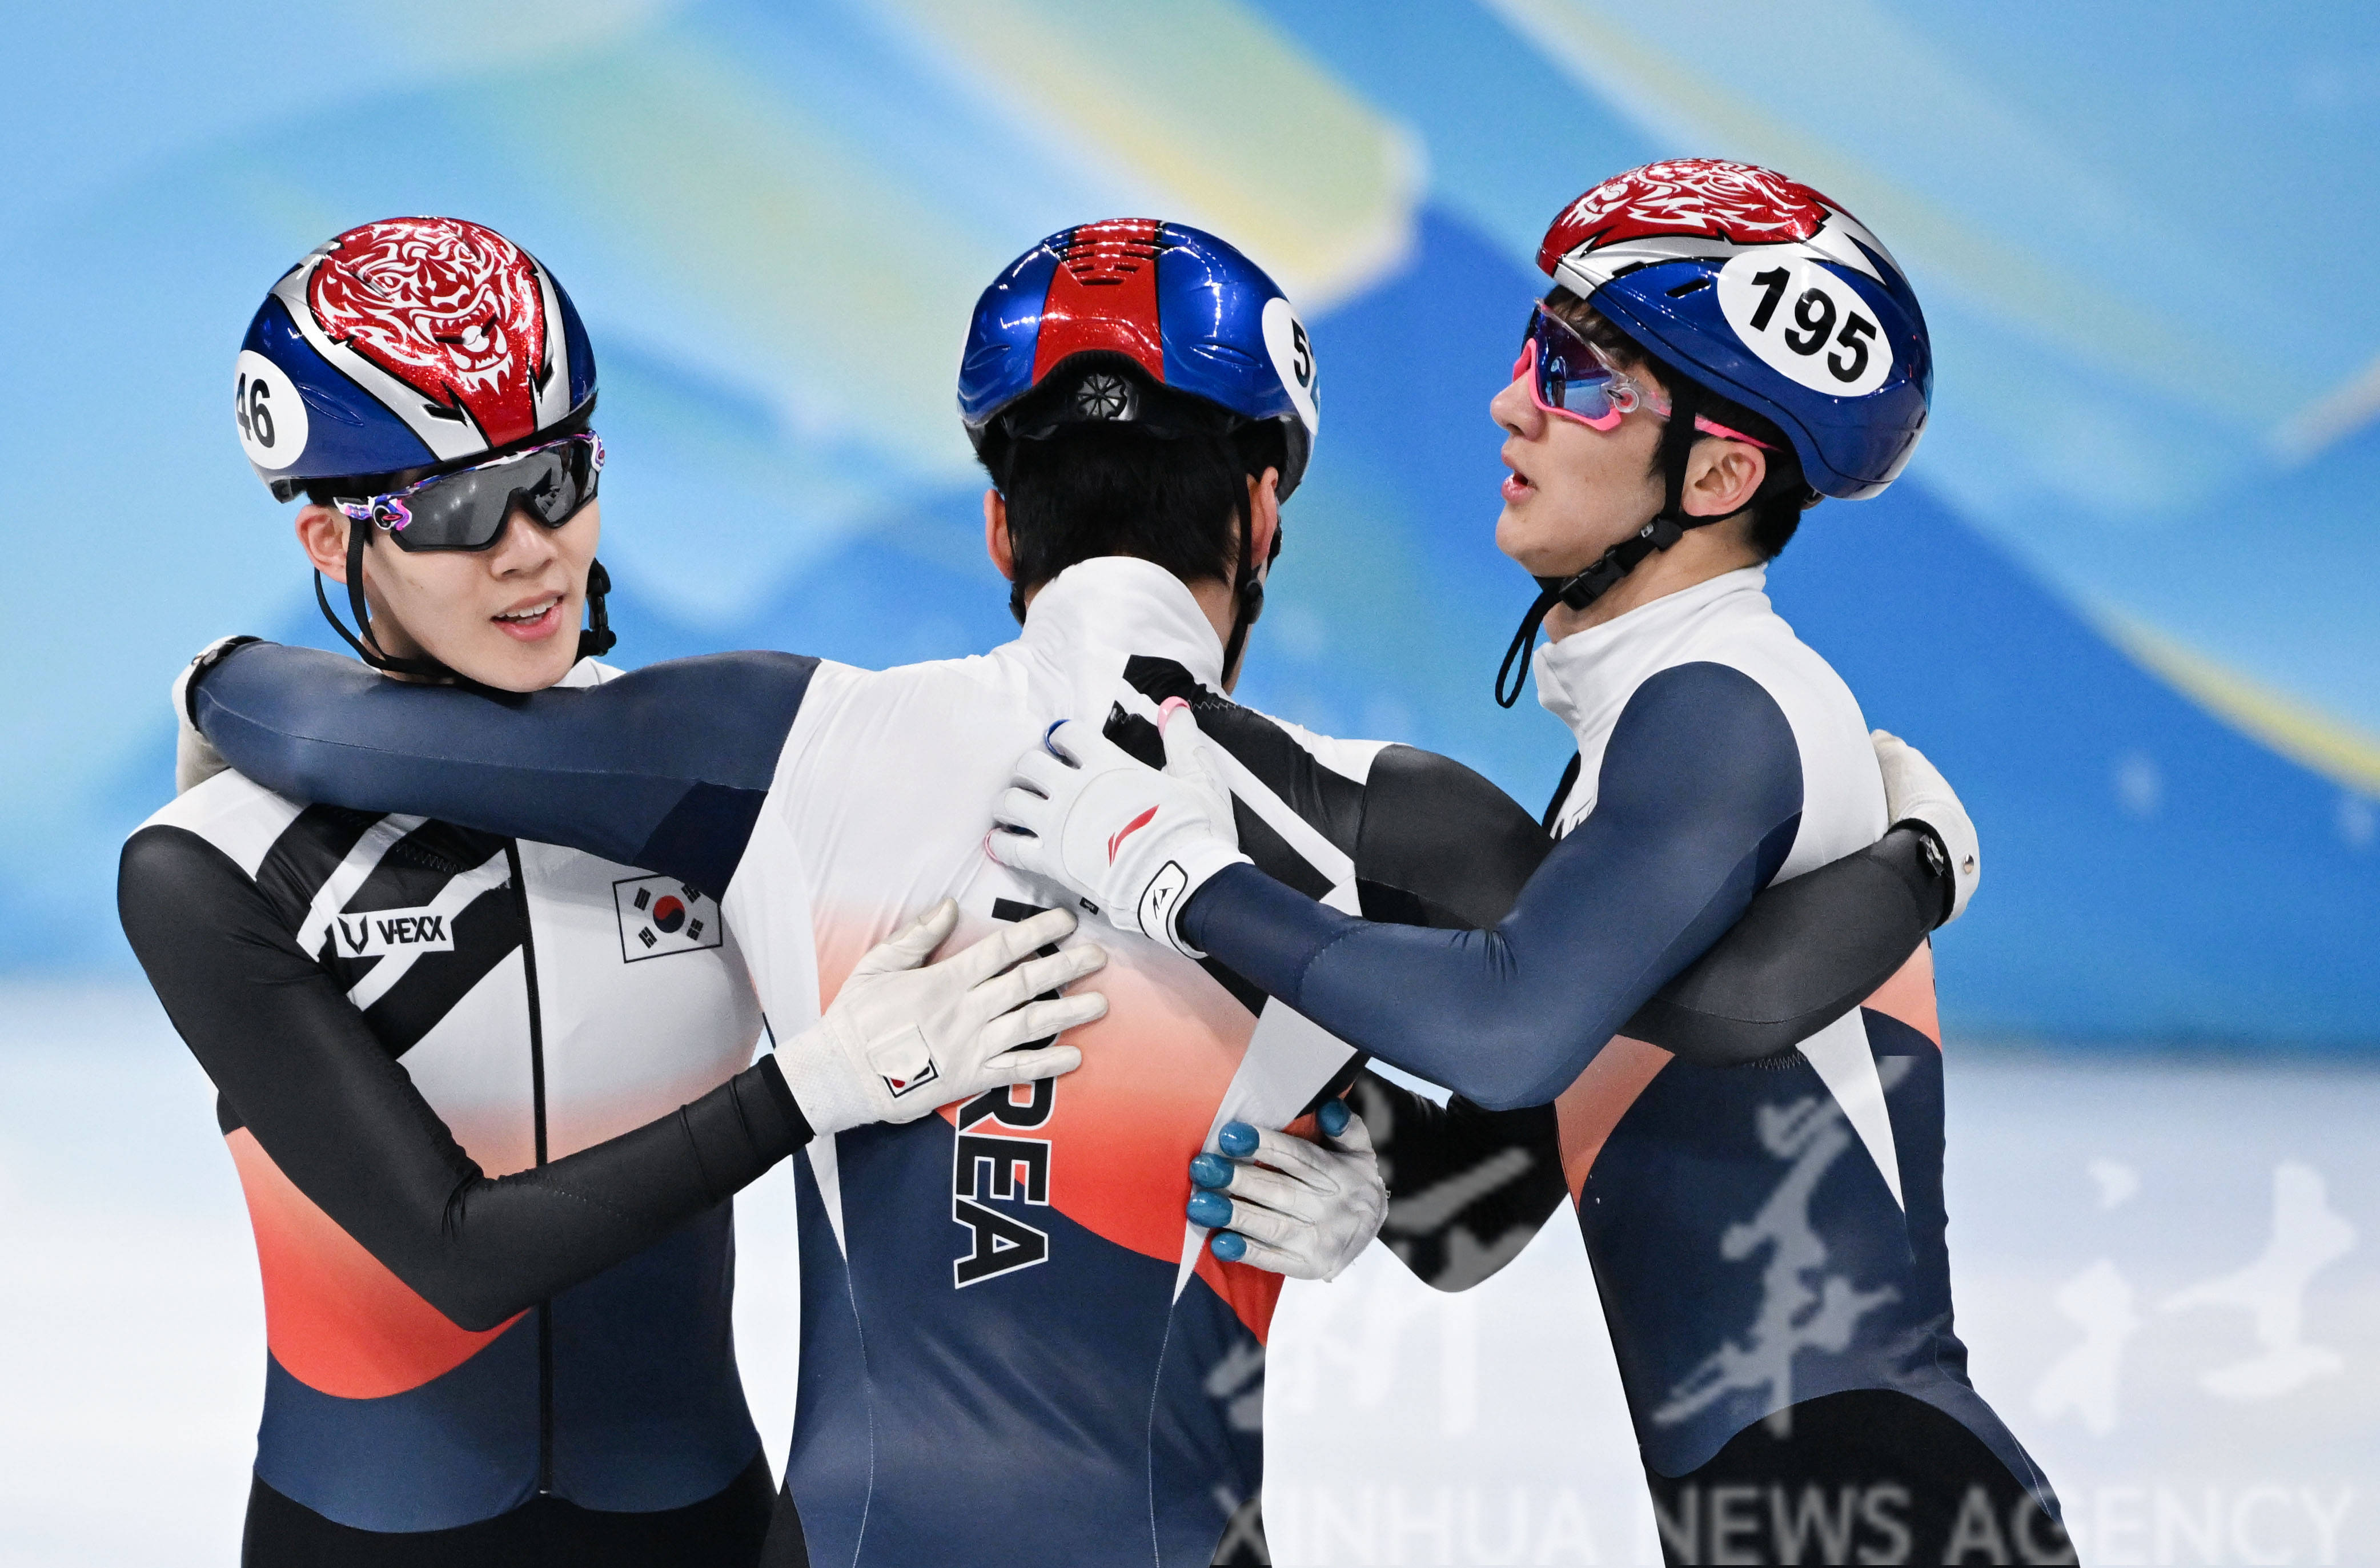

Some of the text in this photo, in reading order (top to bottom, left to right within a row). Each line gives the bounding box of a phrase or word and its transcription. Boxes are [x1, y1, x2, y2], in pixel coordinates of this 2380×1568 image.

[1750, 266, 1877, 383] 195
[376, 916, 446, 944] VEXX
[953, 897, 1062, 1289] REA
